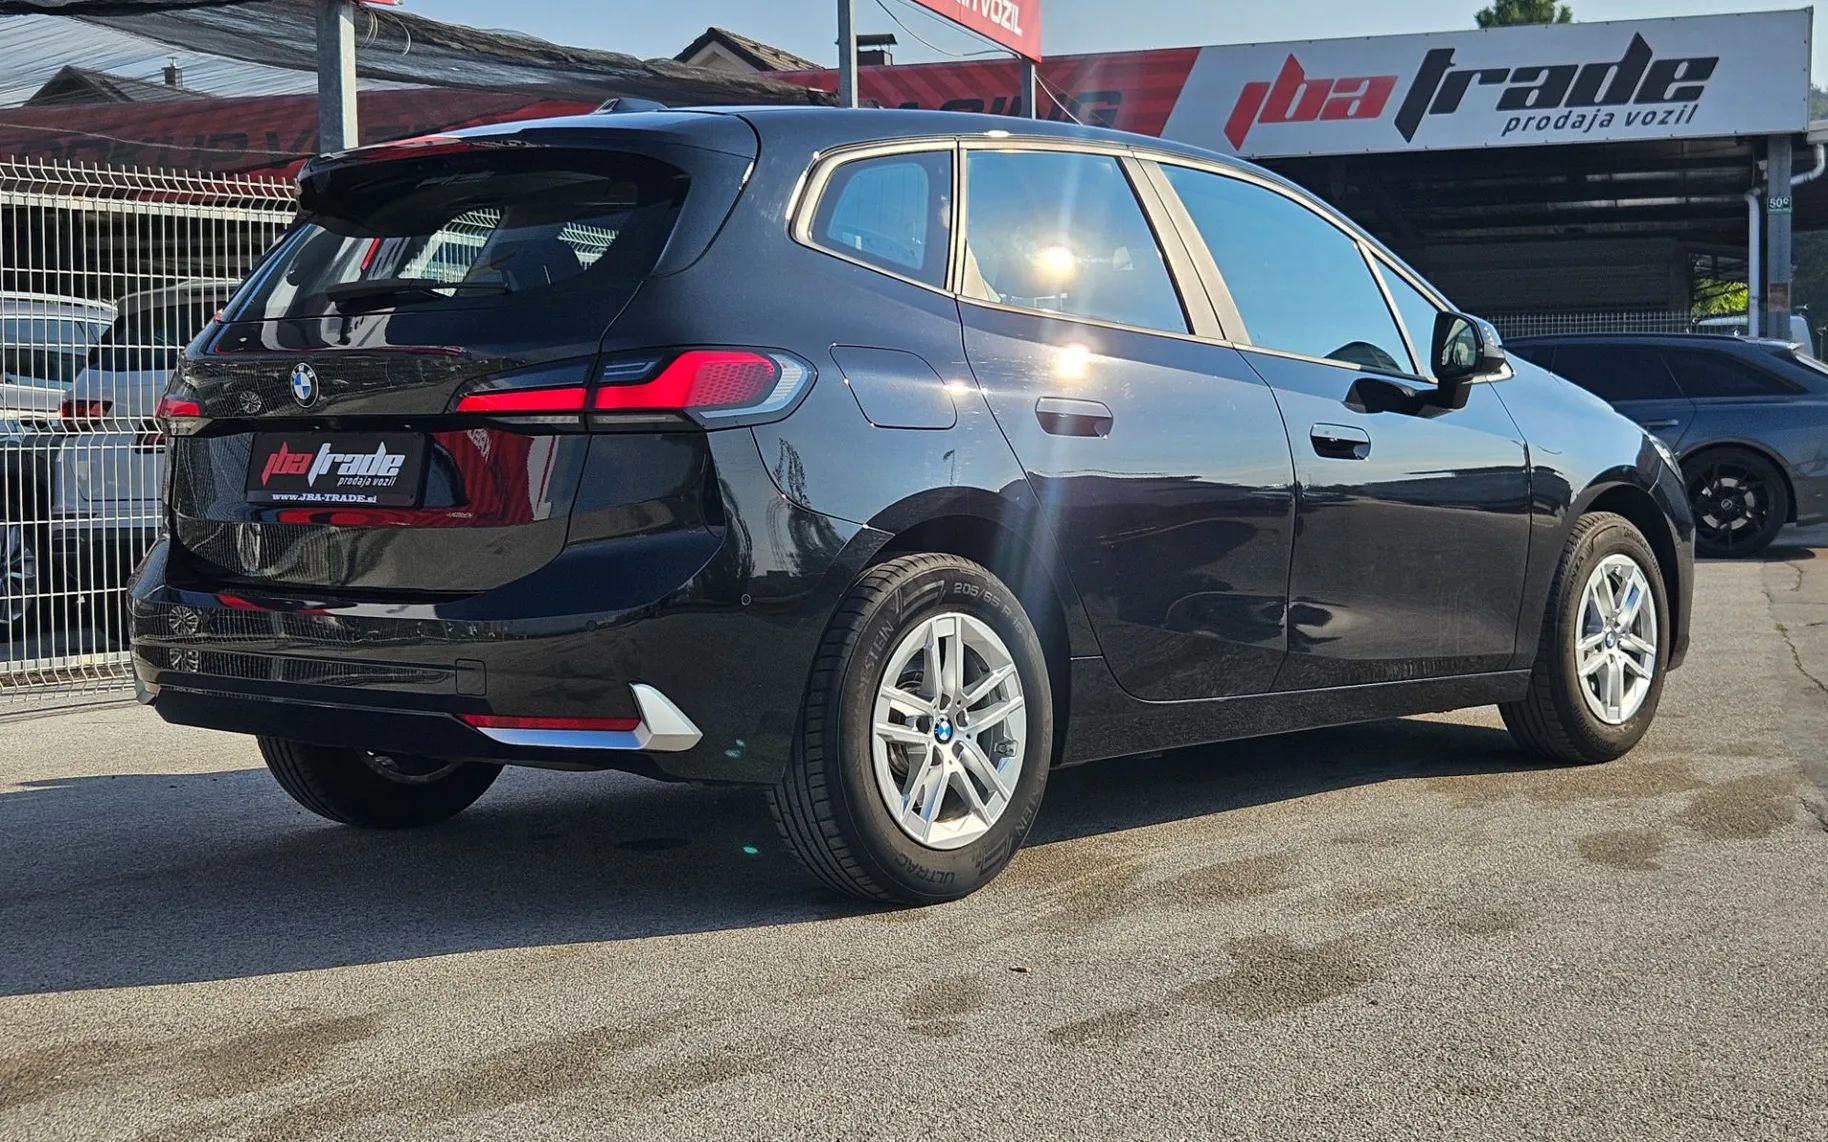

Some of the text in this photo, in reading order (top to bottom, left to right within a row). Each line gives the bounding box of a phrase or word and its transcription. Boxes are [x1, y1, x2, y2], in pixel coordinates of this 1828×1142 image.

[1223, 32, 1720, 152] jba trade
[1501, 103, 1699, 137] prodaja vozil
[261, 441, 406, 488] jba trade
[271, 492, 378, 504] www.JBA-TRADE.si
[336, 476, 397, 488] prodaja vozil
